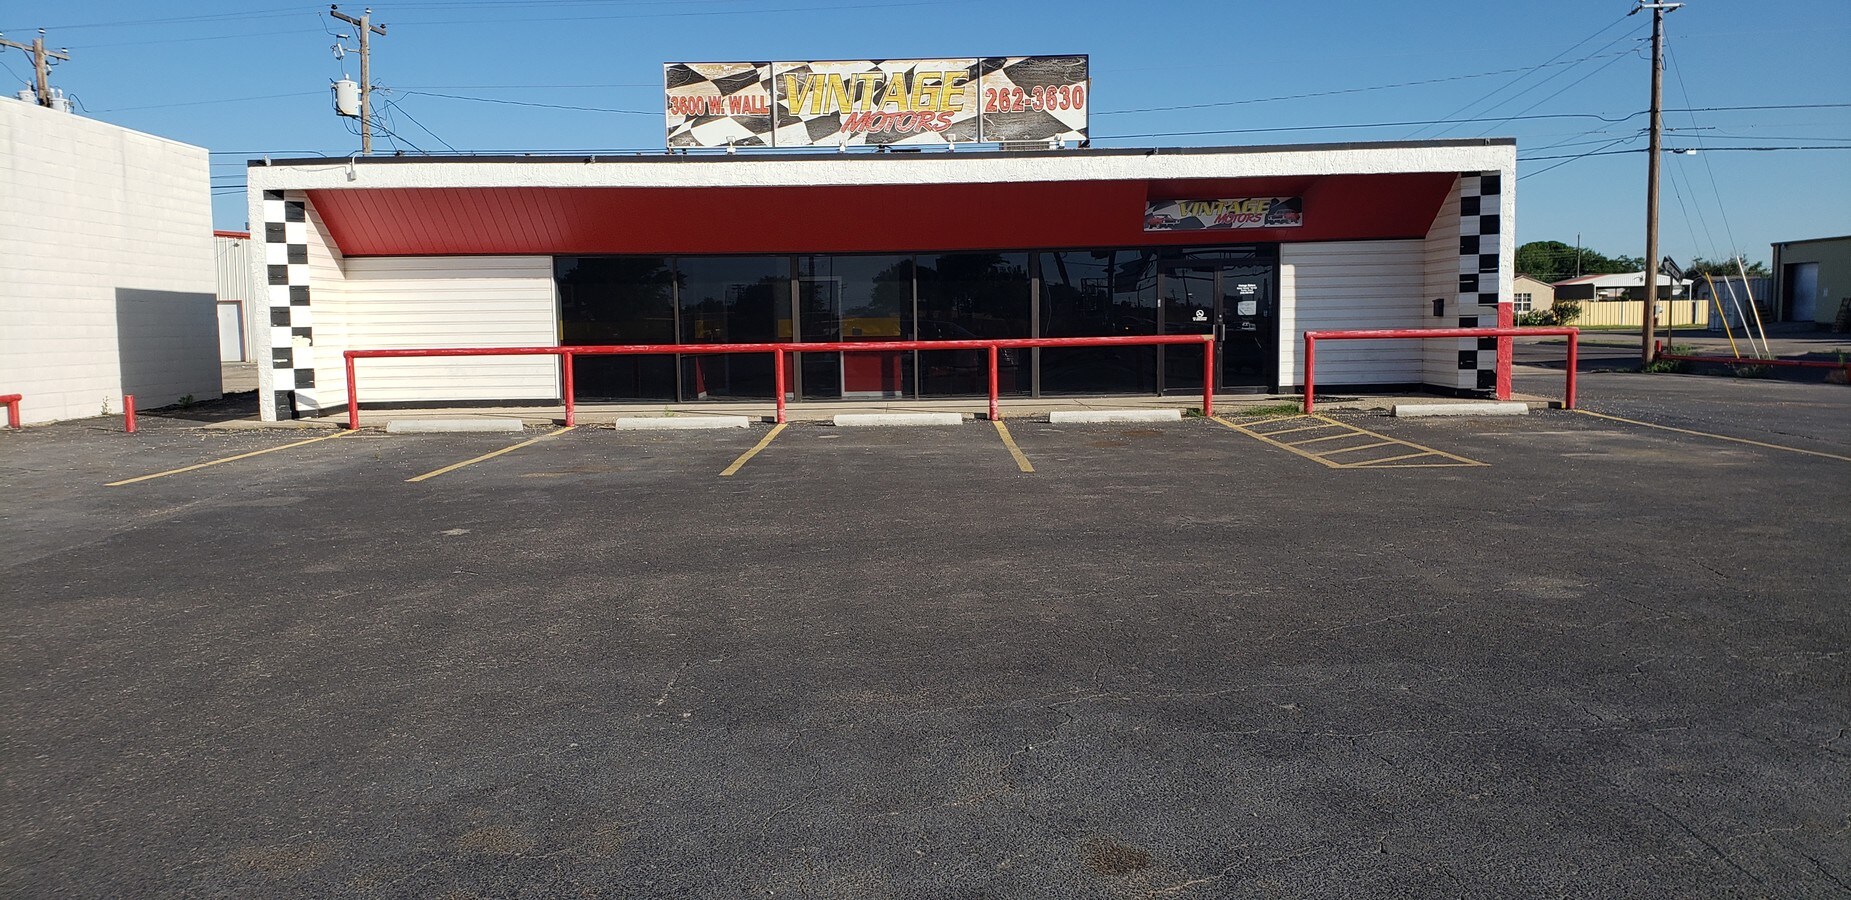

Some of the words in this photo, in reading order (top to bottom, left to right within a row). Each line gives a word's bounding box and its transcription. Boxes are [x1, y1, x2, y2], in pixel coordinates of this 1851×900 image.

[784, 70, 969, 115] VINTAGE
[984, 85, 1085, 112] 262-3630
[670, 95, 705, 115] 3600
[708, 95, 726, 114] W.
[728, 94, 770, 115] WALL
[841, 110, 955, 133] MOTORS
[1179, 199, 1271, 217] VINTAGE
[1214, 213, 1262, 224] MOTORS
